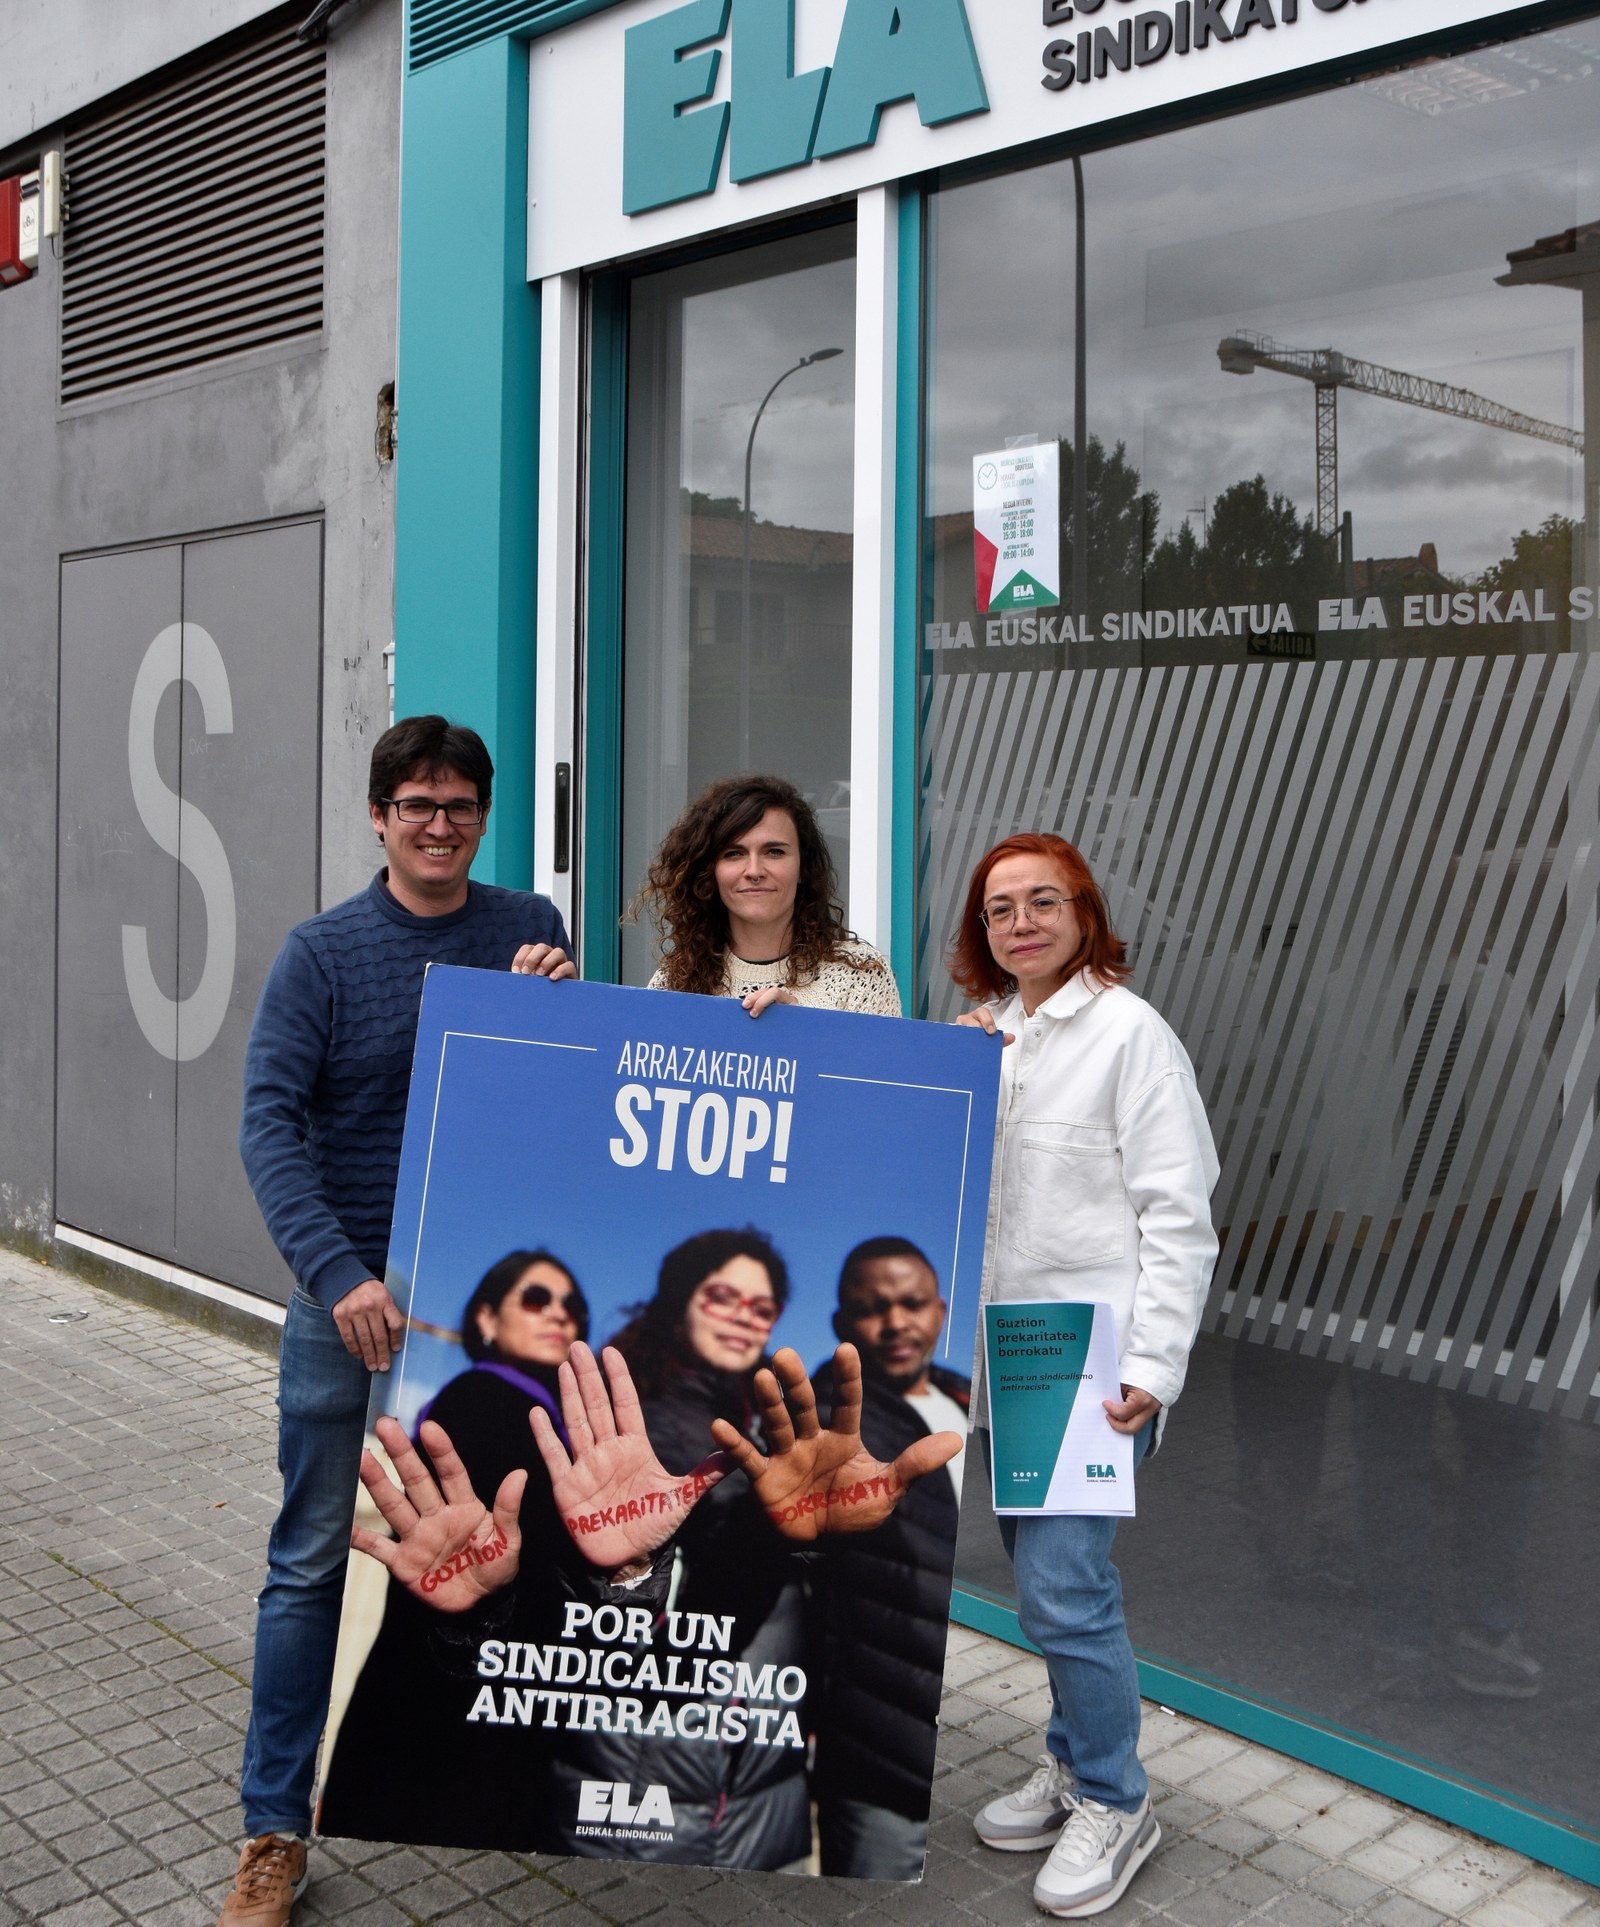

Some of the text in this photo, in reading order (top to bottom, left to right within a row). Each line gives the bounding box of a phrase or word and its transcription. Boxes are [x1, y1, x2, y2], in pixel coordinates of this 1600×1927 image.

[622, 0, 990, 216] ELA
[1003, 521, 1016, 530] 09:00
[1020, 519, 1033, 528] 14:00
[1003, 531, 1016, 540] 15:30
[1003, 550, 1017, 559] 09:00
[1020, 548, 1034, 557] 14:00
[1013, 584, 1034, 597] ELA
[925, 621, 975, 649] ELA
[986, 614, 1094, 646] EUSKAL
[1101, 603, 1295, 642] SINDIKATUA
[1318, 597, 1388, 631] ELA
[1403, 589, 1555, 627] EUSKAL
[121, 622, 236, 1061] S
[616, 1041, 797, 1094] ARRAZAKERIARI
[609, 1084, 794, 1183] STOP!
[996, 1318, 1046, 1328] Guztion
[998, 1332, 1076, 1345] prekaritatea
[998, 1346, 1062, 1357] borrokatu
[1000, 1374, 1024, 1382] Hacia
[1039, 1372, 1093, 1381] sindicalismo
[1000, 1383, 1050, 1391] antirracista
[1086, 1465, 1117, 1478] ELA
[560, 1602, 735, 1652] POR UN
[477, 1640, 807, 1702] SINDICALISMO
[466, 1685, 805, 1748] ANTIRRACISTA
[577, 1780, 675, 1827] ELA
[576, 1826, 673, 1841] EUSKAL SINDIKATUA
